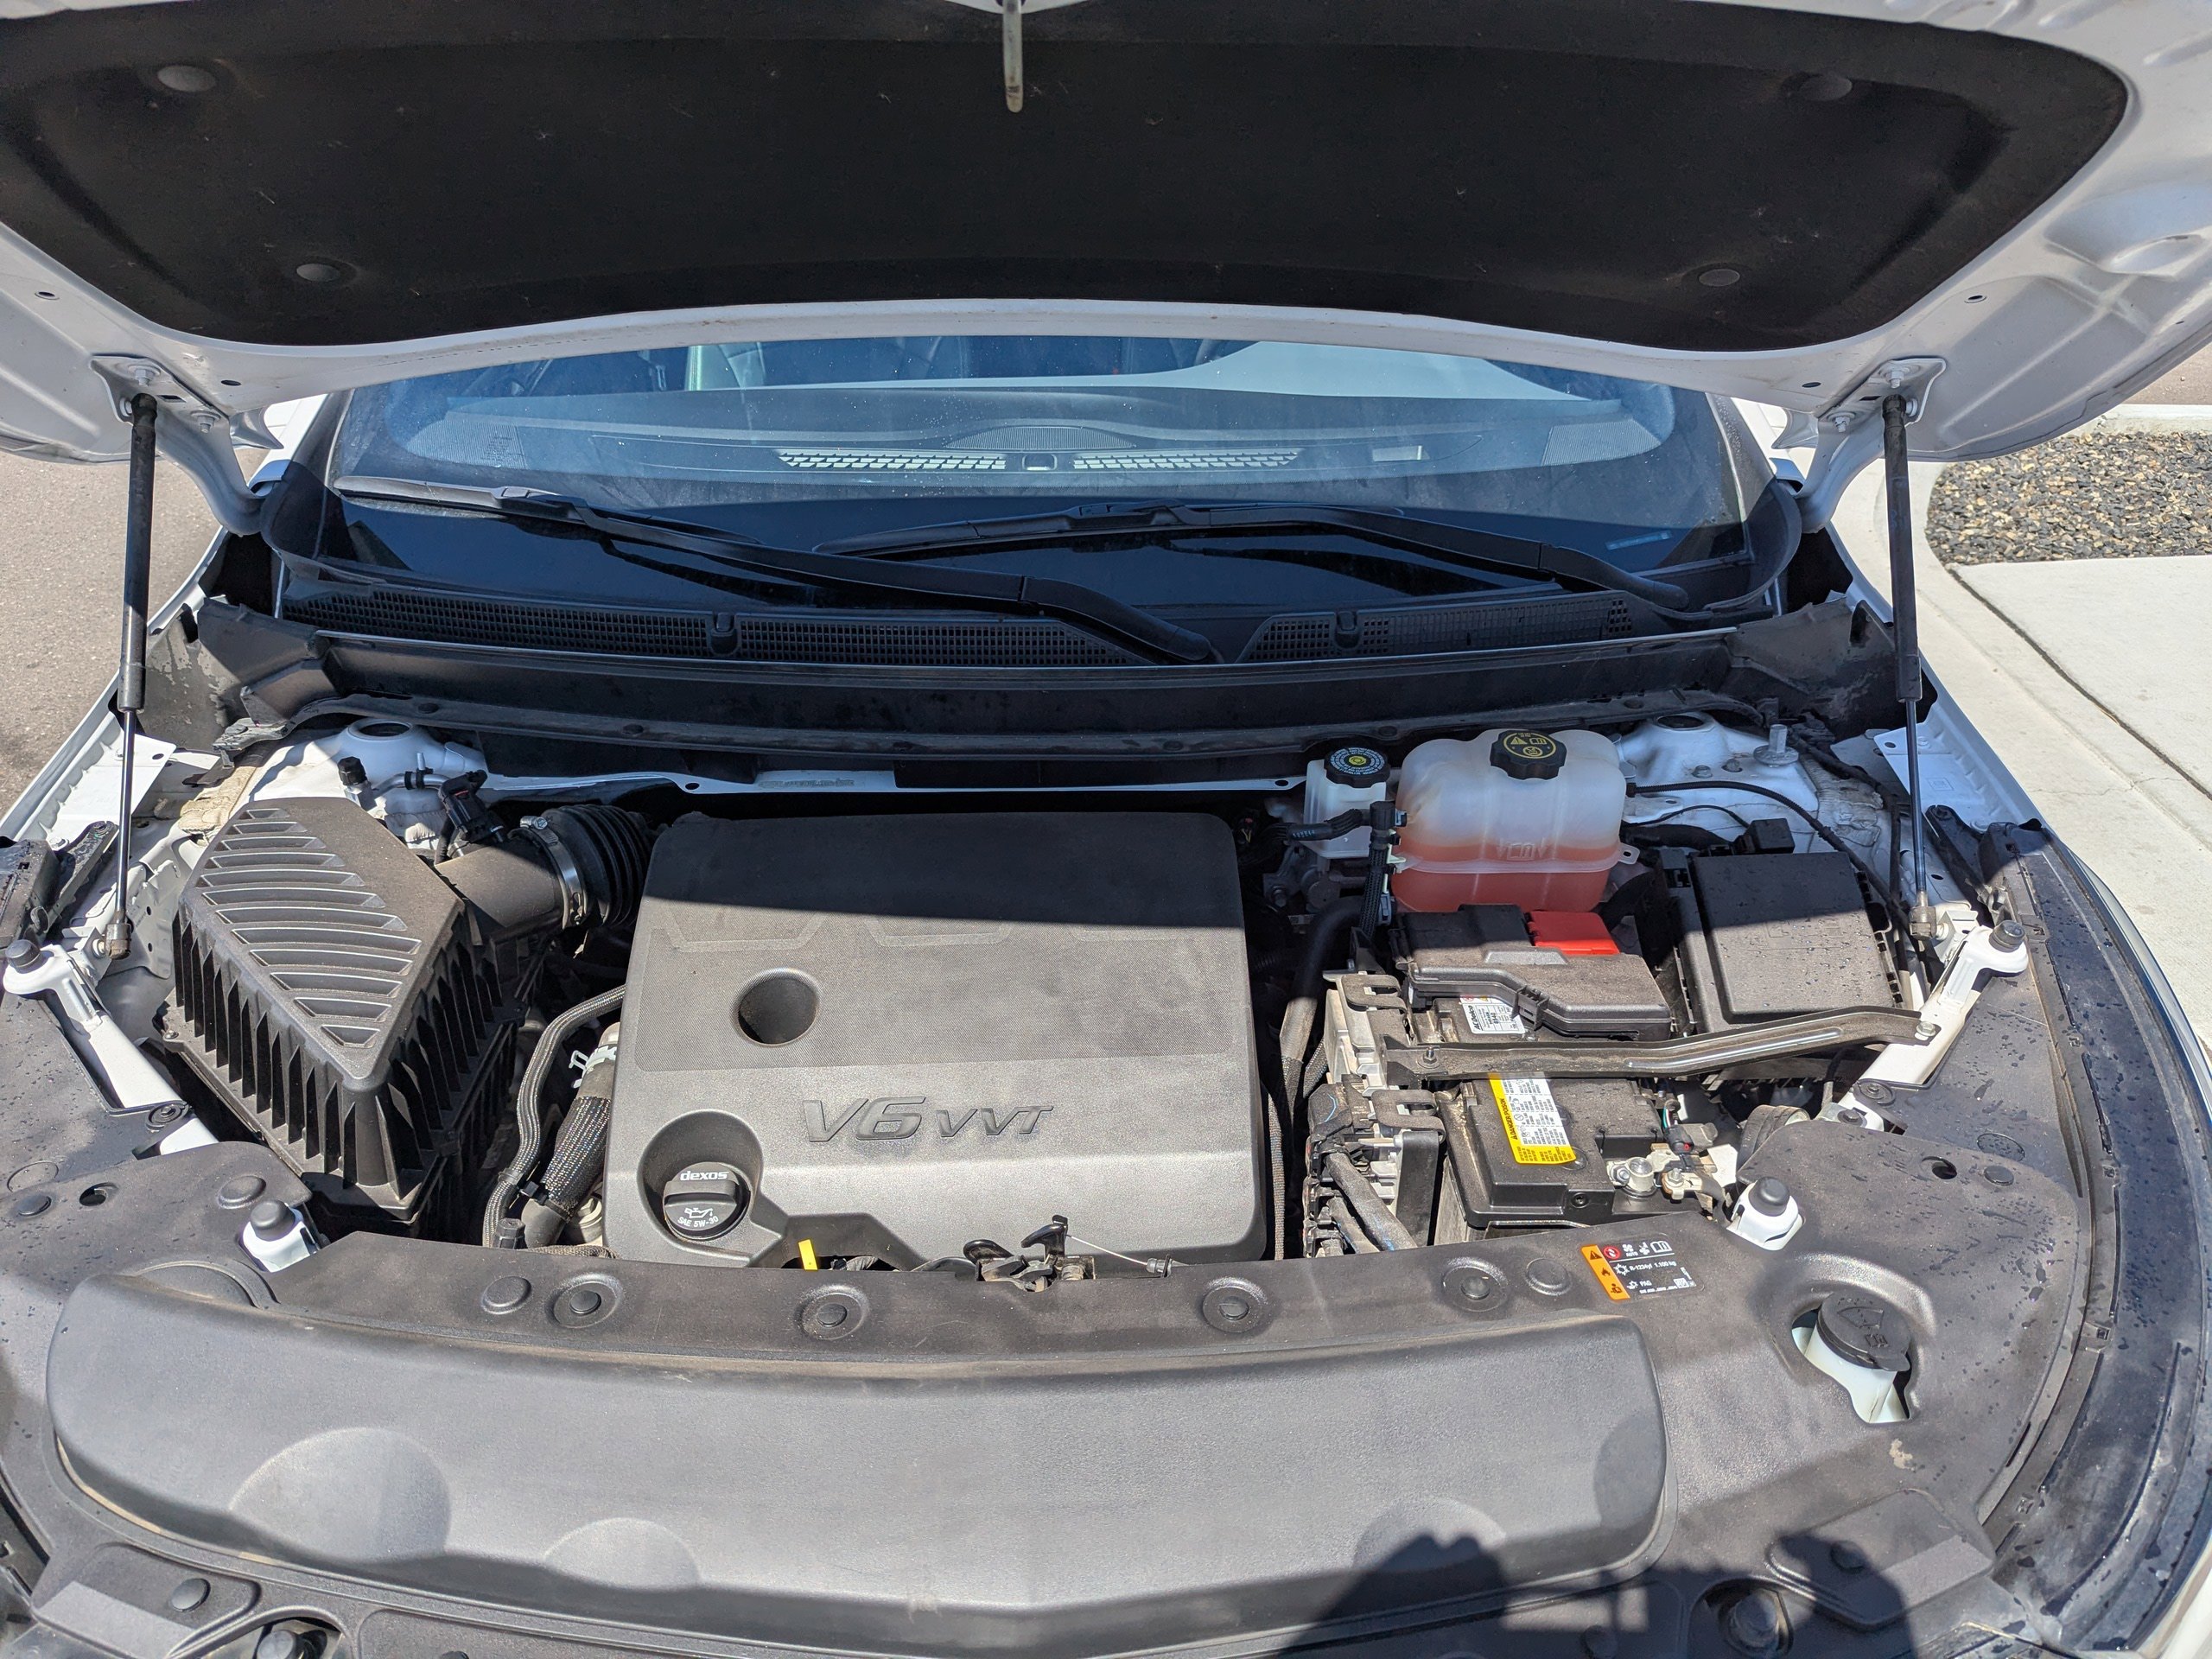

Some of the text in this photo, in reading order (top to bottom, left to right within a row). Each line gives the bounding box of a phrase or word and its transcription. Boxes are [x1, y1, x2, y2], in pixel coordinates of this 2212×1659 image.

[802, 1096, 1054, 1142] V6 VVT
[680, 1170, 729, 1181] dexos
[677, 1216, 719, 1228] SAE 5W-30
